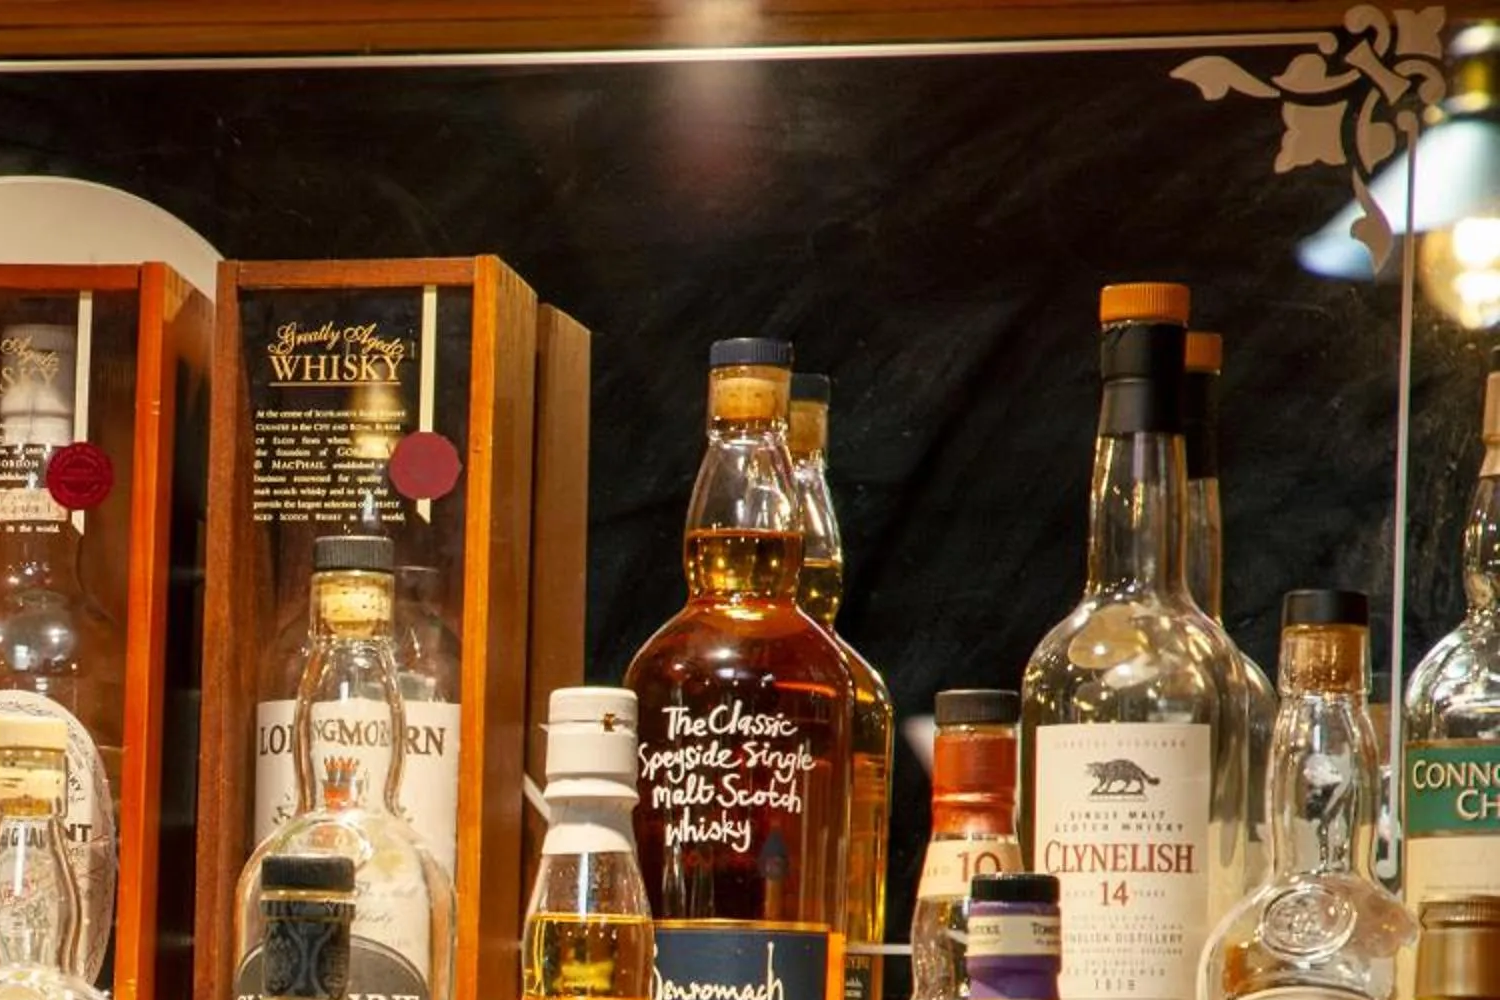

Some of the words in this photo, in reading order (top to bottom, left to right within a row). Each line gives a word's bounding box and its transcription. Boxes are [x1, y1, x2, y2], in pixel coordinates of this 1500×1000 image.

[269, 355, 404, 381] WHISKY
[662, 707, 707, 740] The
[709, 700, 797, 737] Classic
[638, 740, 742, 783] Speyside
[742, 742, 816, 782] Single
[717, 774, 801, 813] Scotch
[1055, 823, 1109, 833] SCOTCH
[1122, 823, 1185, 833] WHISKY
[1128, 810, 1166, 820] MALT
[1045, 839, 1194, 873] CLYNELISH
[1099, 879, 1129, 907] 14
